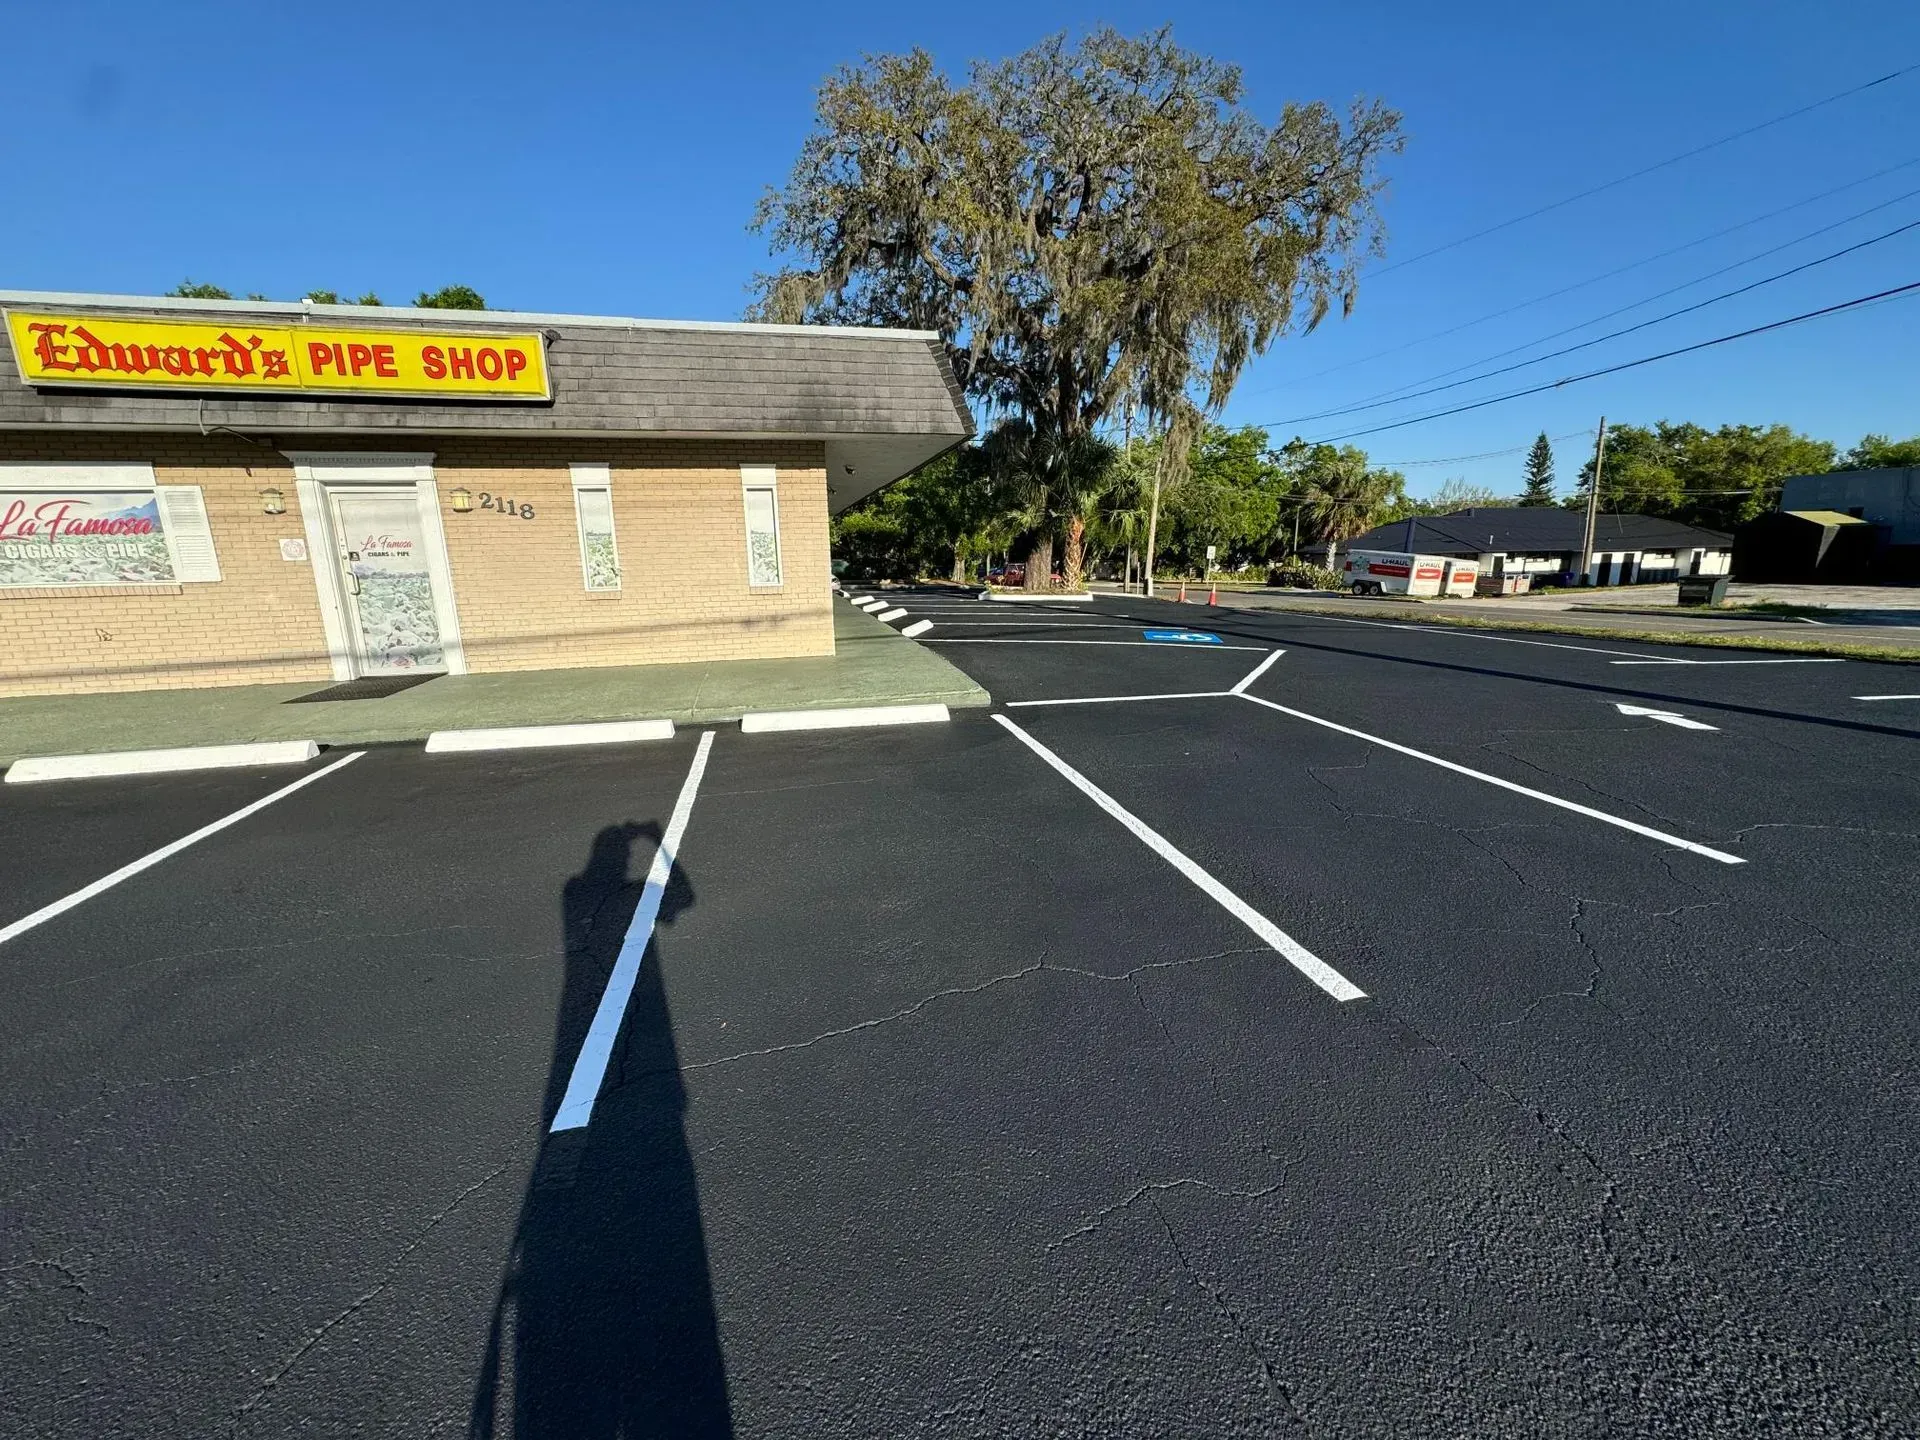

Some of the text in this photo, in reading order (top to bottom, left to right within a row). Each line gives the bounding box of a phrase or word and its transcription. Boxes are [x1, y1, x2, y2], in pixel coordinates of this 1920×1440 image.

[28, 322, 527, 381] Edward's PIPE SHOP
[478, 492, 535, 520] 2118
[0, 499, 152, 543] La Famosa
[4, 543, 78, 559] CIGARS
[105, 542, 148, 559] PIPE
[360, 534, 413, 552] La Famosa
[1381, 558, 1409, 566] U-HAUL
